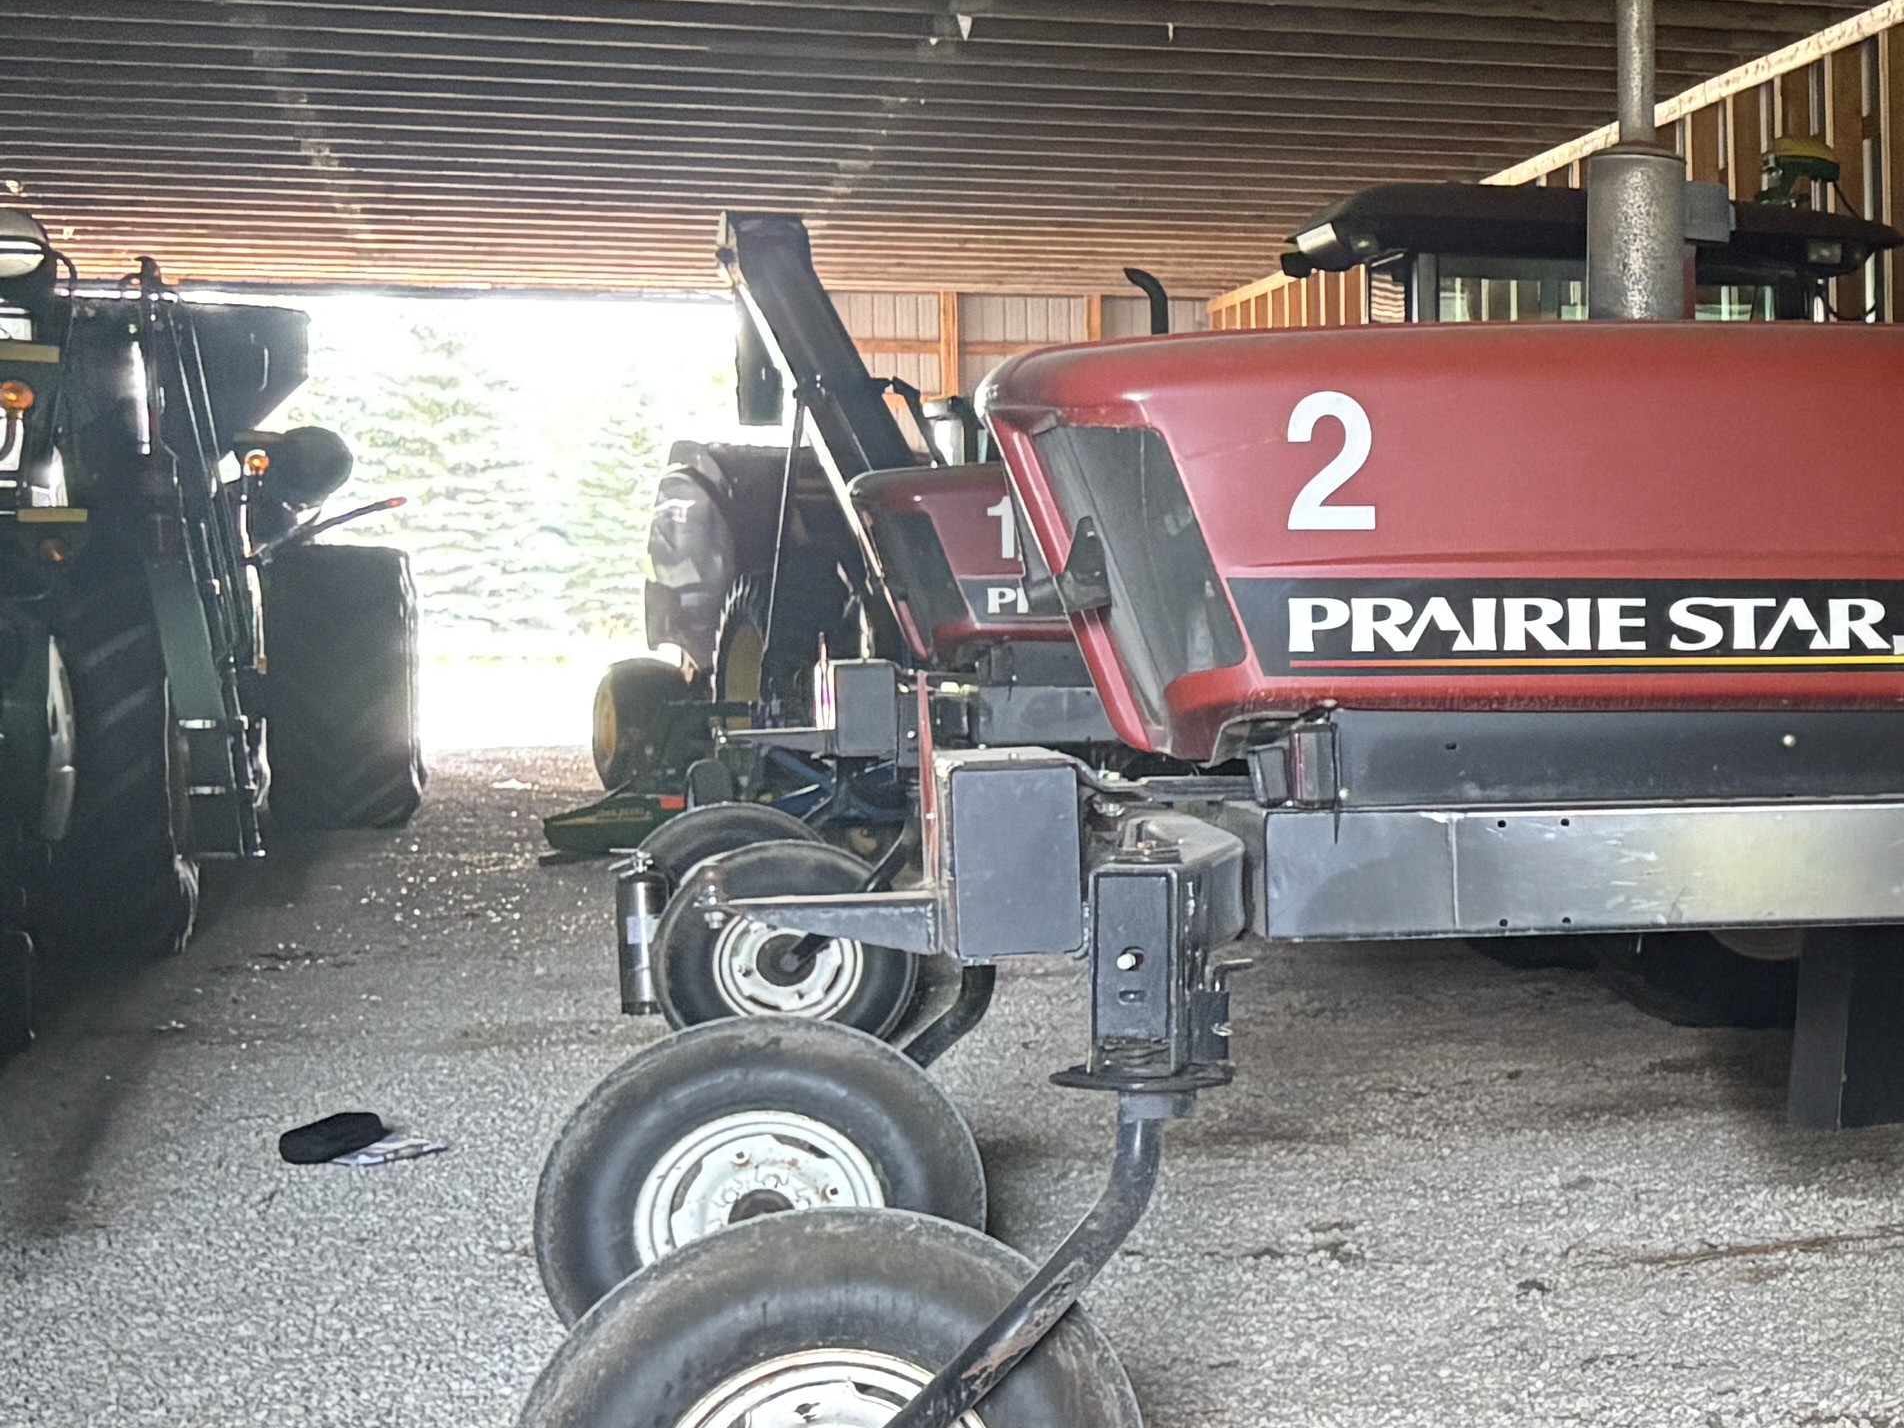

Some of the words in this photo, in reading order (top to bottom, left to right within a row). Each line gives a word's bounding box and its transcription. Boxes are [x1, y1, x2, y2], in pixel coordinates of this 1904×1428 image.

[1287, 391, 1376, 530] 2
[987, 495, 1015, 559] 1
[1287, 596, 1647, 653] PRAIRIE
[1668, 596, 1893, 652] STAR
